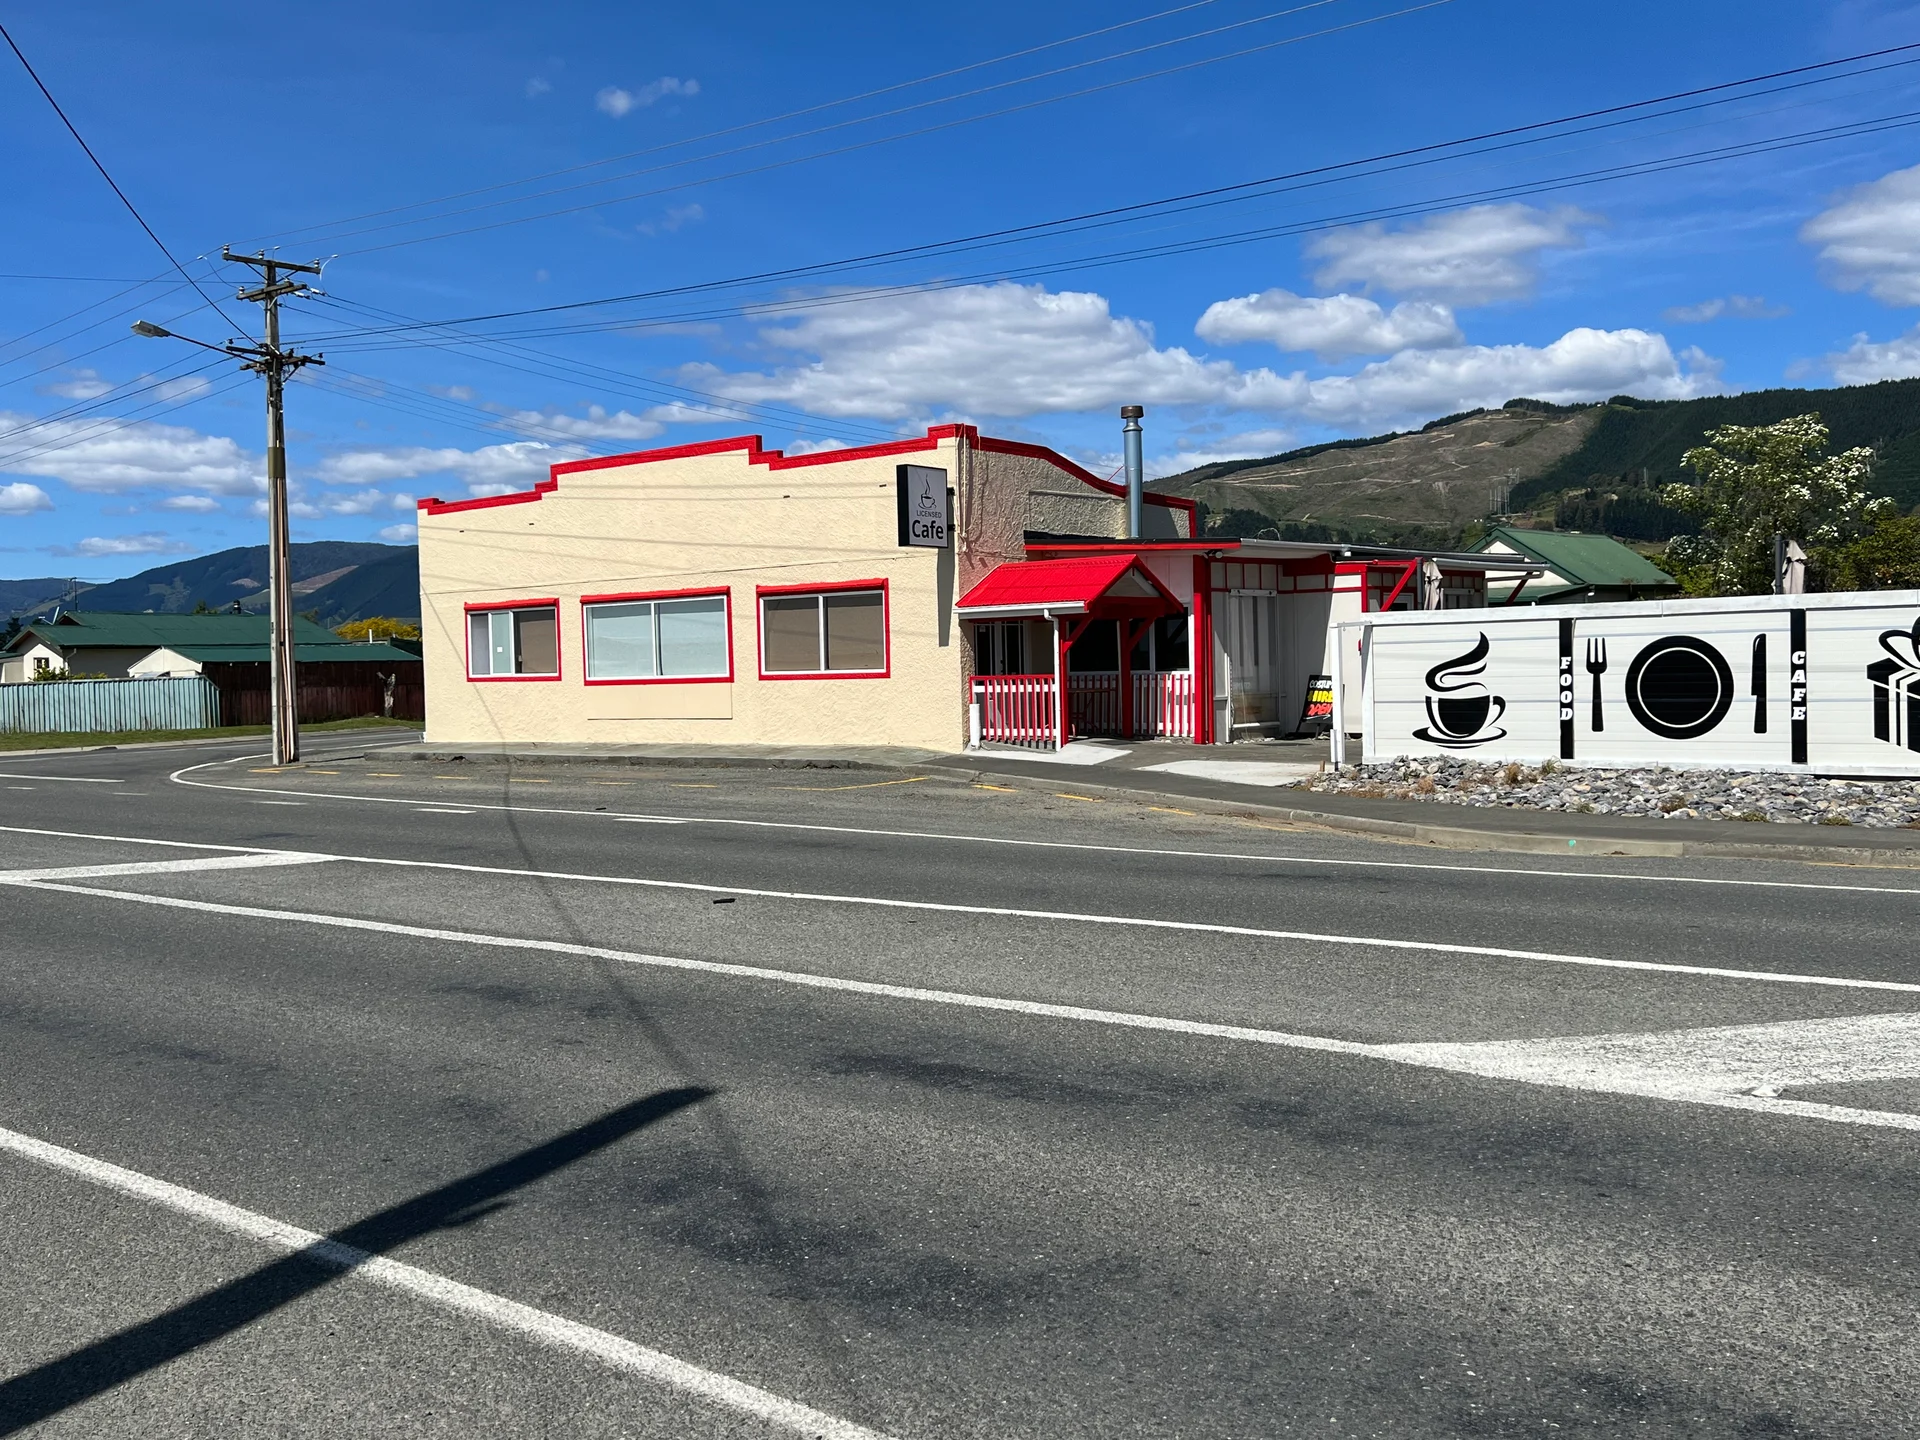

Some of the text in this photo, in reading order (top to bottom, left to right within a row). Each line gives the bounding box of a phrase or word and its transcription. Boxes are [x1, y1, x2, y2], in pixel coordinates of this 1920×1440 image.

[912, 519, 944, 539] Cafe
[916, 510, 942, 518] LICENSED
[1560, 656, 1573, 720] FOOD
[1791, 650, 1806, 720] CAFE
